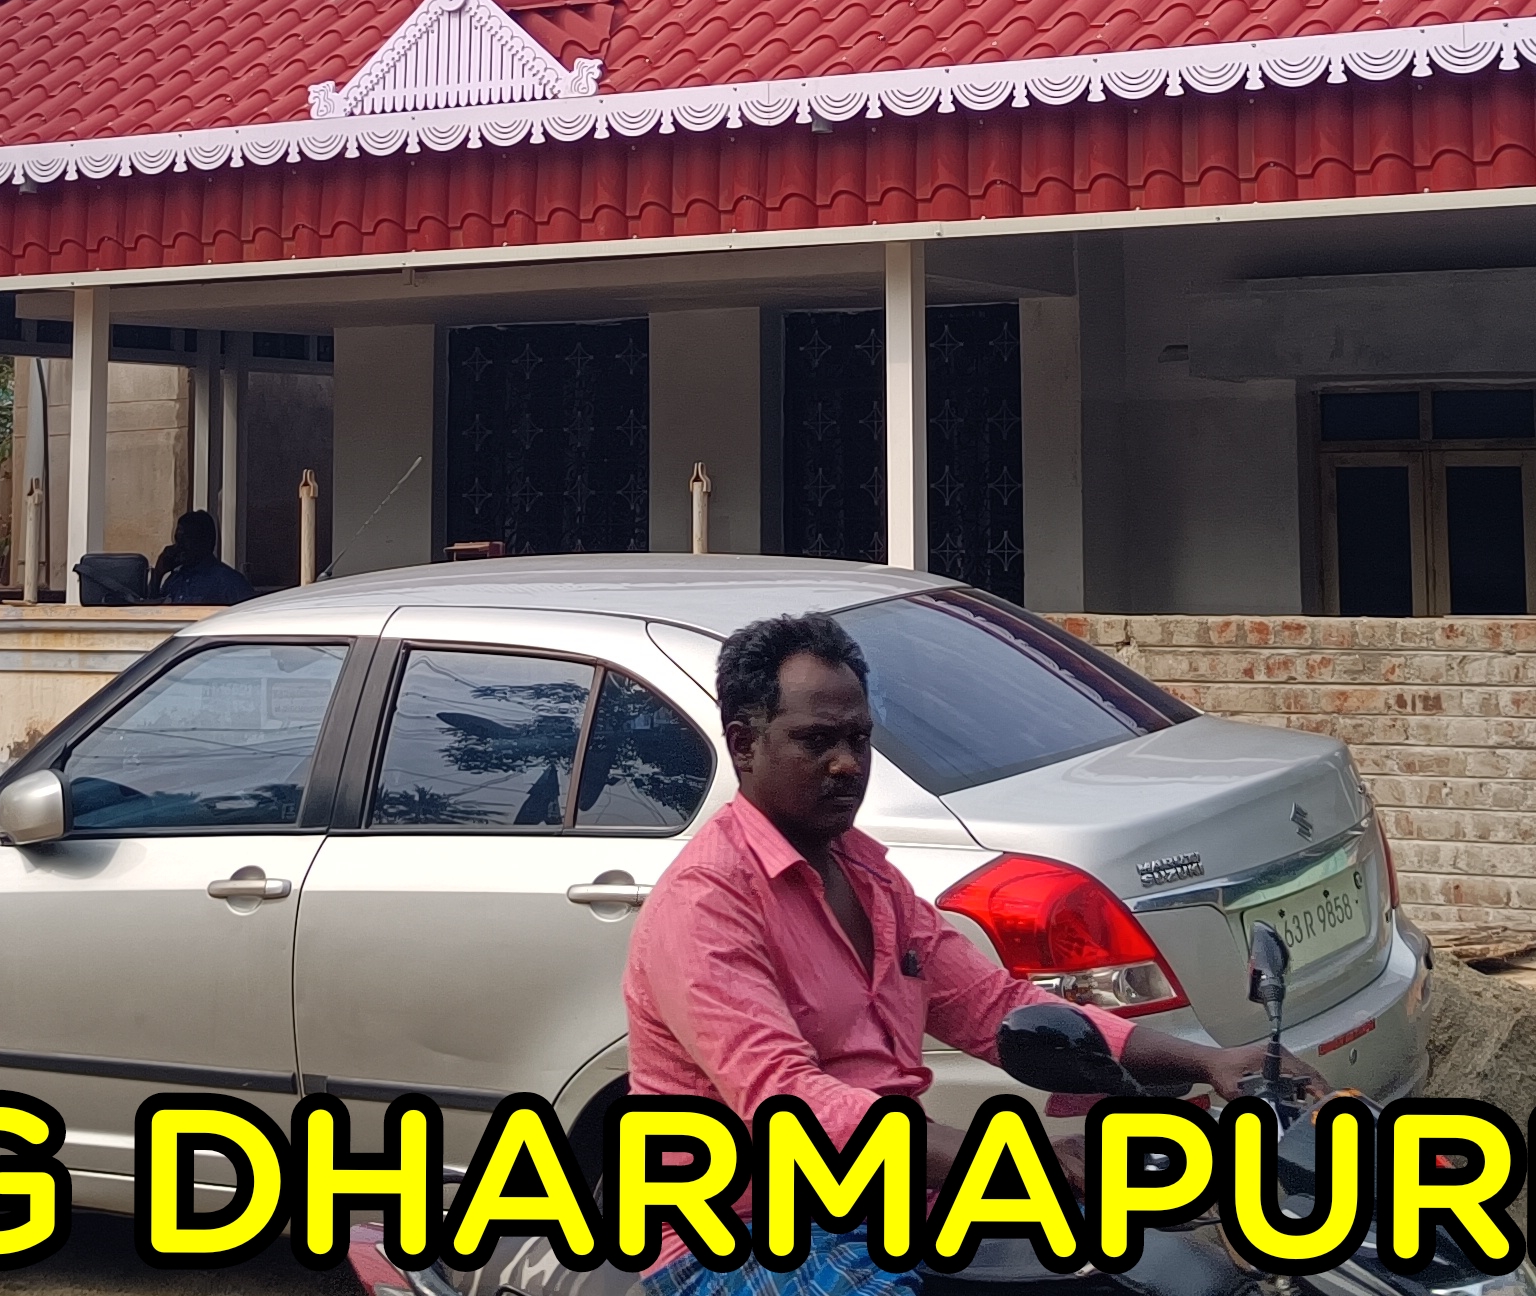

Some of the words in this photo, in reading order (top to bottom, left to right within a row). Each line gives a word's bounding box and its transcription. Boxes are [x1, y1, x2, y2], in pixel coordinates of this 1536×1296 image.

[1136, 851, 1201, 875] MARUTI
[1141, 862, 1205, 888] SUZUKI
[1316, 893, 1354, 932] 9858
